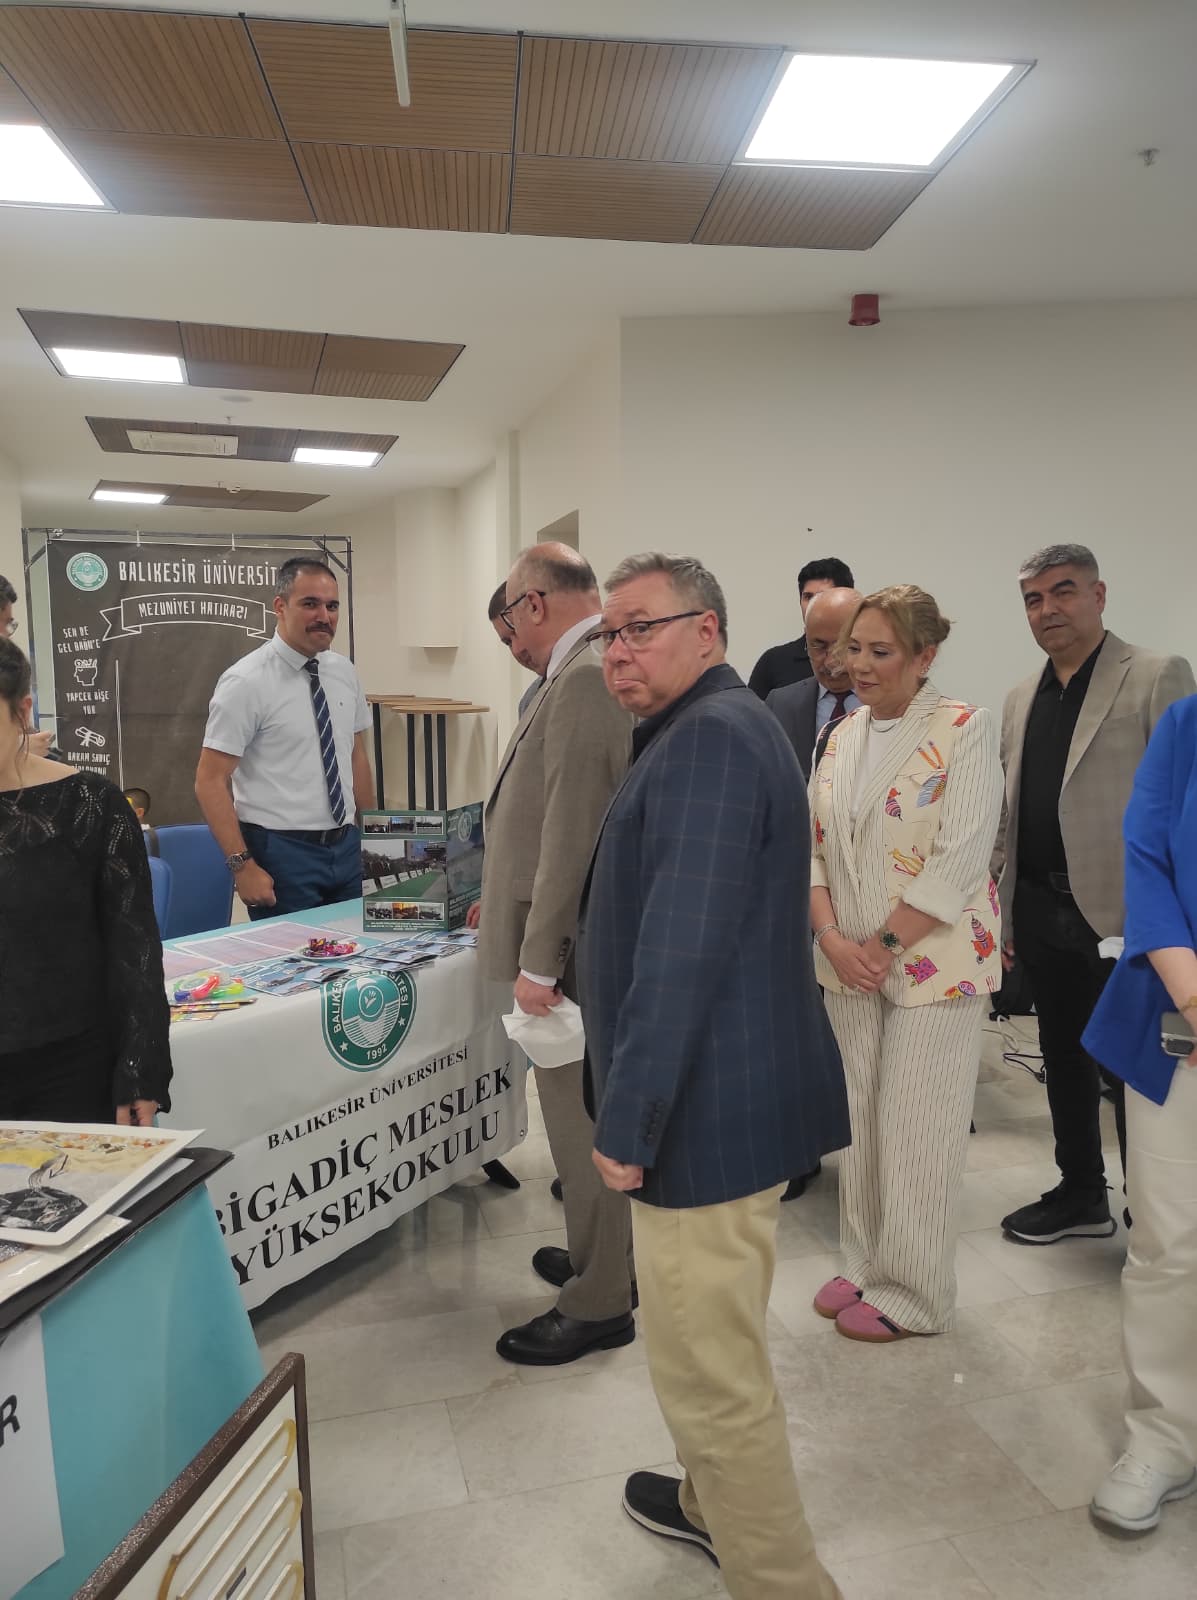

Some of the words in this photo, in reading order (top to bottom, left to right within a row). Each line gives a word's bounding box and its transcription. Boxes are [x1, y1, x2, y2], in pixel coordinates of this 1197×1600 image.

[119, 558, 197, 584] BALIKESİR
[203, 559, 281, 586] ÜNİVERSİT
[138, 598, 196, 618] MEZUNİYET
[62, 627, 78, 639] SEN
[79, 625, 89, 637] DE
[57, 642, 73, 654] GEL
[331, 980, 344, 1034] BALIKES
[366, 1043, 388, 1060] 1992
[268, 1097, 366, 1150] BALIKESİR
[370, 1042, 468, 1105] ÜNİVERSİTESİ
[388, 1061, 512, 1154] MESLEK
[230, 1111, 500, 1286] YÜKSEKOKULU
